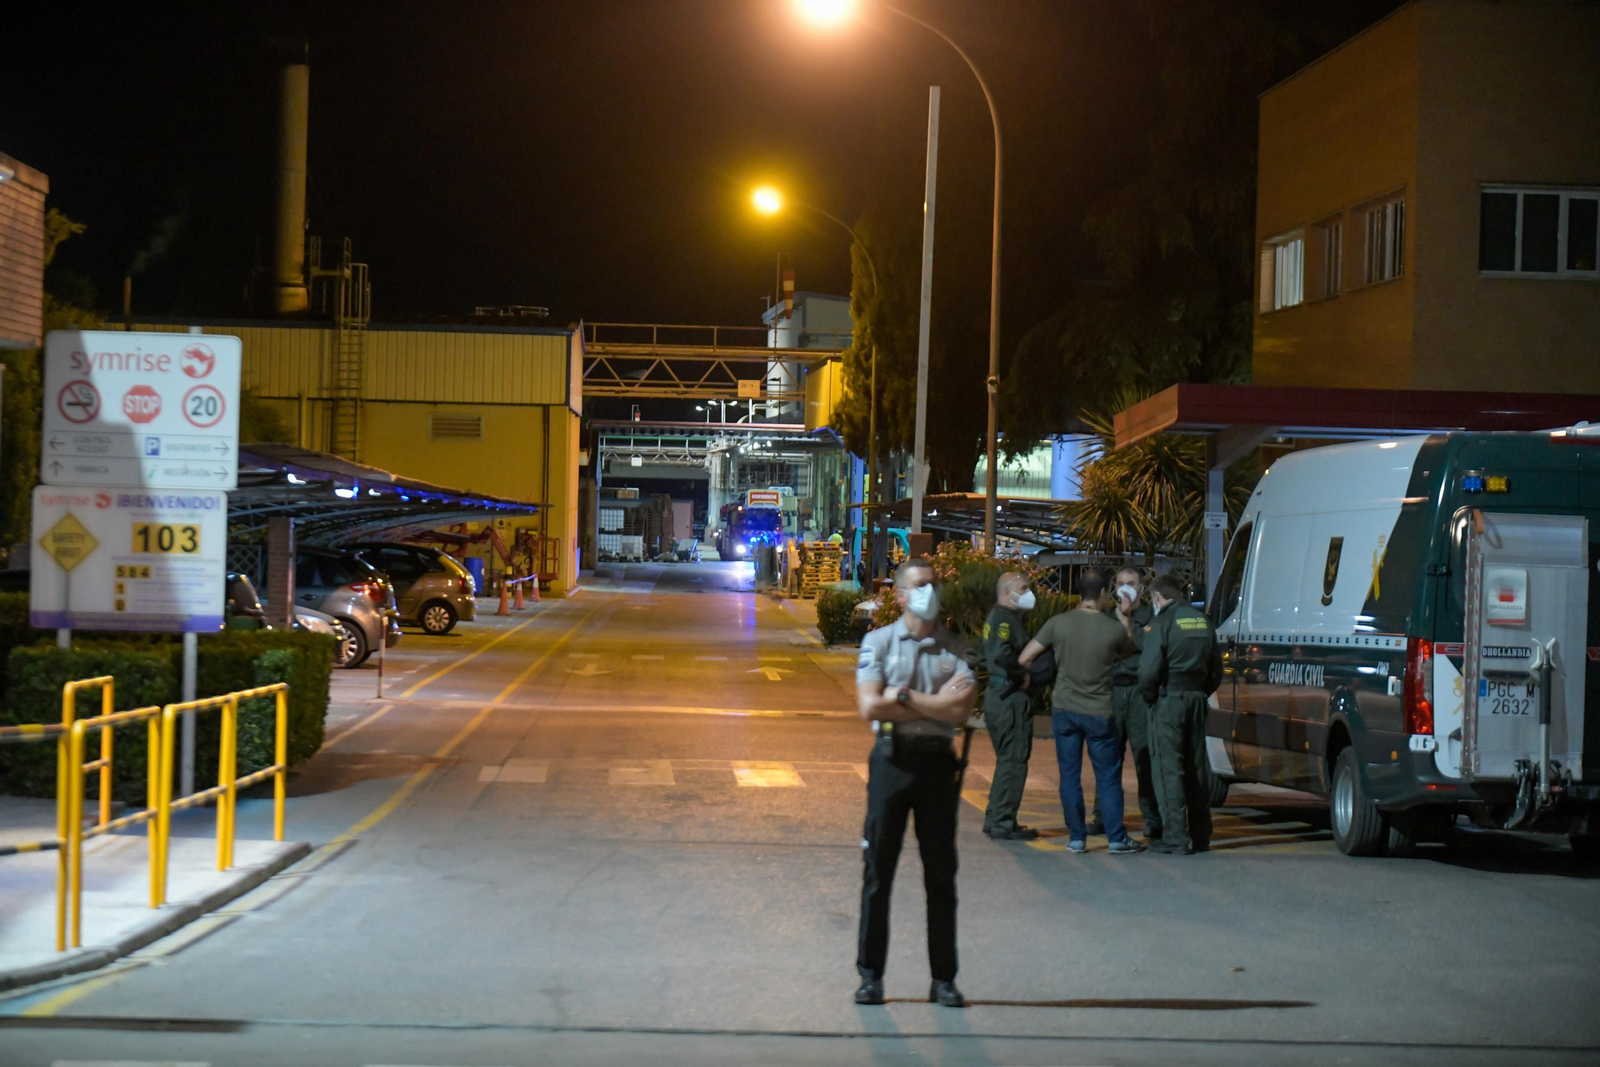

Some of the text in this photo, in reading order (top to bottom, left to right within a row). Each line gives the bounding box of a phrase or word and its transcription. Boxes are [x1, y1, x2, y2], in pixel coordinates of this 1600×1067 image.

[71, 347, 171, 375] symrise
[126, 394, 160, 413] STOP
[191, 396, 217, 416] 20
[117, 494, 221, 510] ¡BIENVENIDO!
[138, 525, 197, 553] 103
[1482, 647, 1531, 657] DHOLLANDIA
[1268, 662, 1325, 687] GUARDIA CIVIL
[1488, 682, 1535, 698] PGC M
[1492, 698, 1530, 715] 2632
